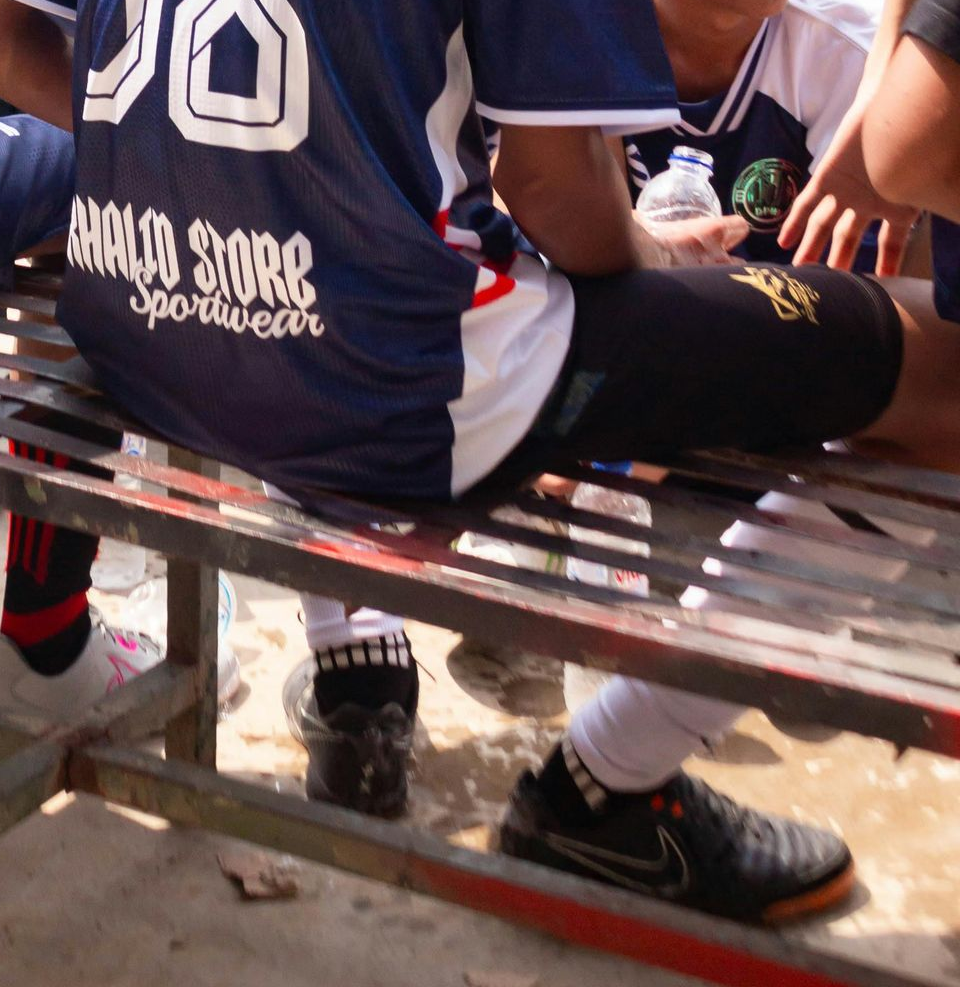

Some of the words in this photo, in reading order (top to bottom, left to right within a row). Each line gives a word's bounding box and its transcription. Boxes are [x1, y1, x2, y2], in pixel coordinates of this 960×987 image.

[66, 193, 182, 292] KHALID
[187, 216, 317, 310] STORE
[129, 266, 326, 340] Sportwear
